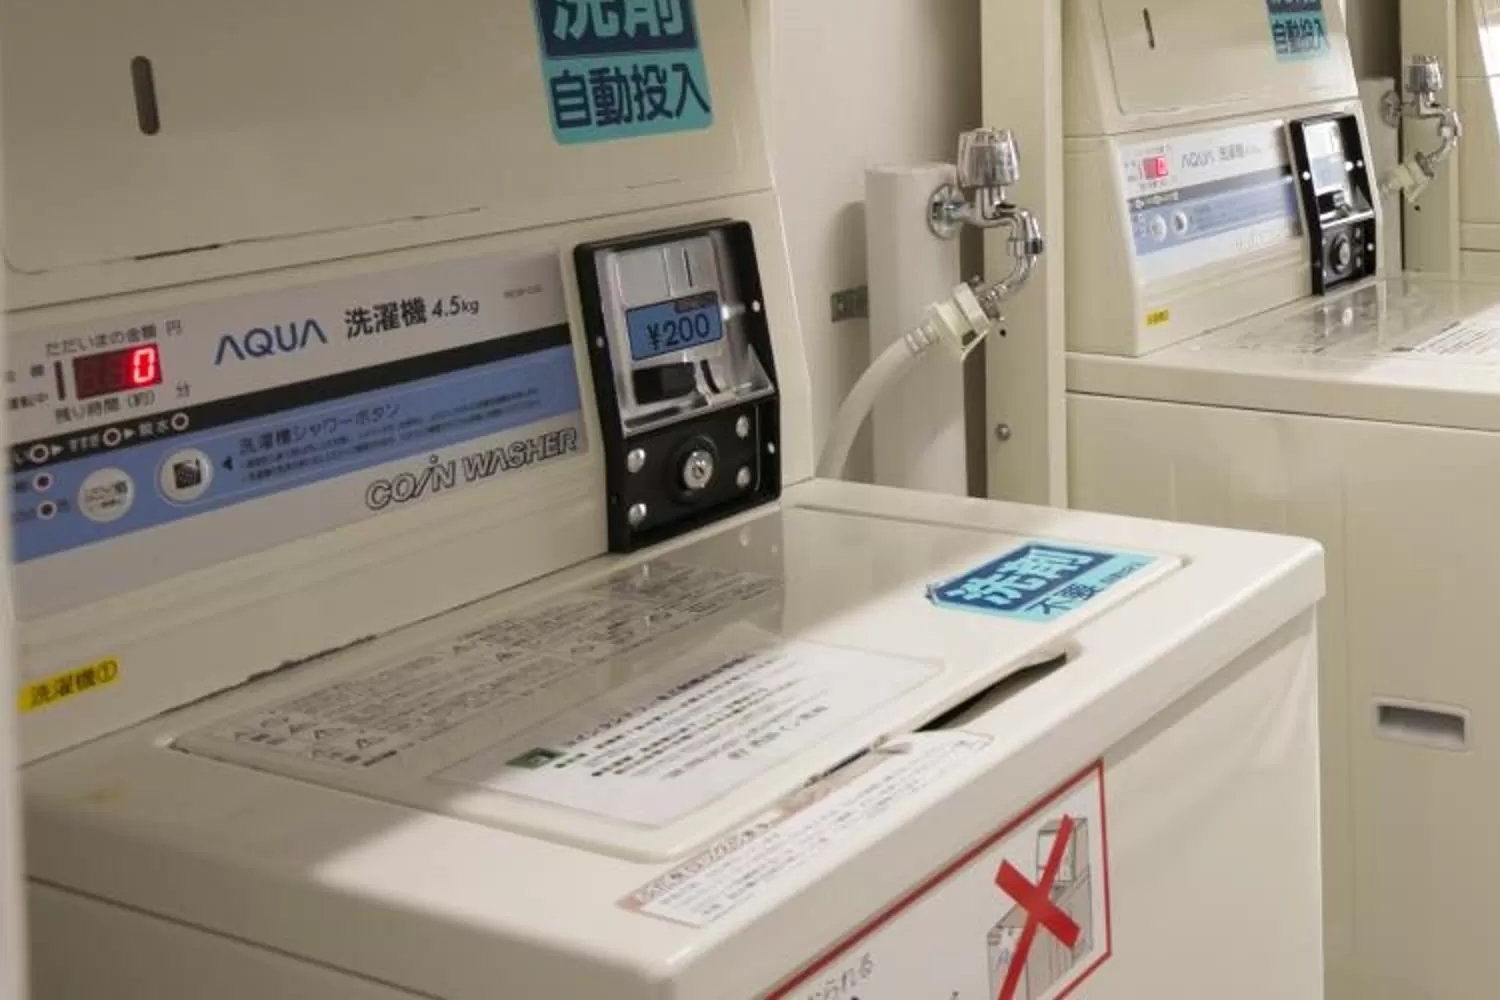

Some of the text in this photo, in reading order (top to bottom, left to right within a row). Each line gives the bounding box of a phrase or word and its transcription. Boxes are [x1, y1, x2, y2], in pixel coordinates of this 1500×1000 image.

[550, 62, 711, 129] 自動投入
[214, 295, 480, 366] AQUA 洗濯機 4.5kg
[646, 312, 711, 350] ¥200
[132, 347, 156, 384] 0
[365, 455, 455, 511] COIN
[462, 427, 578, 485] WASHER
[944, 547, 1095, 605] 洗剤
